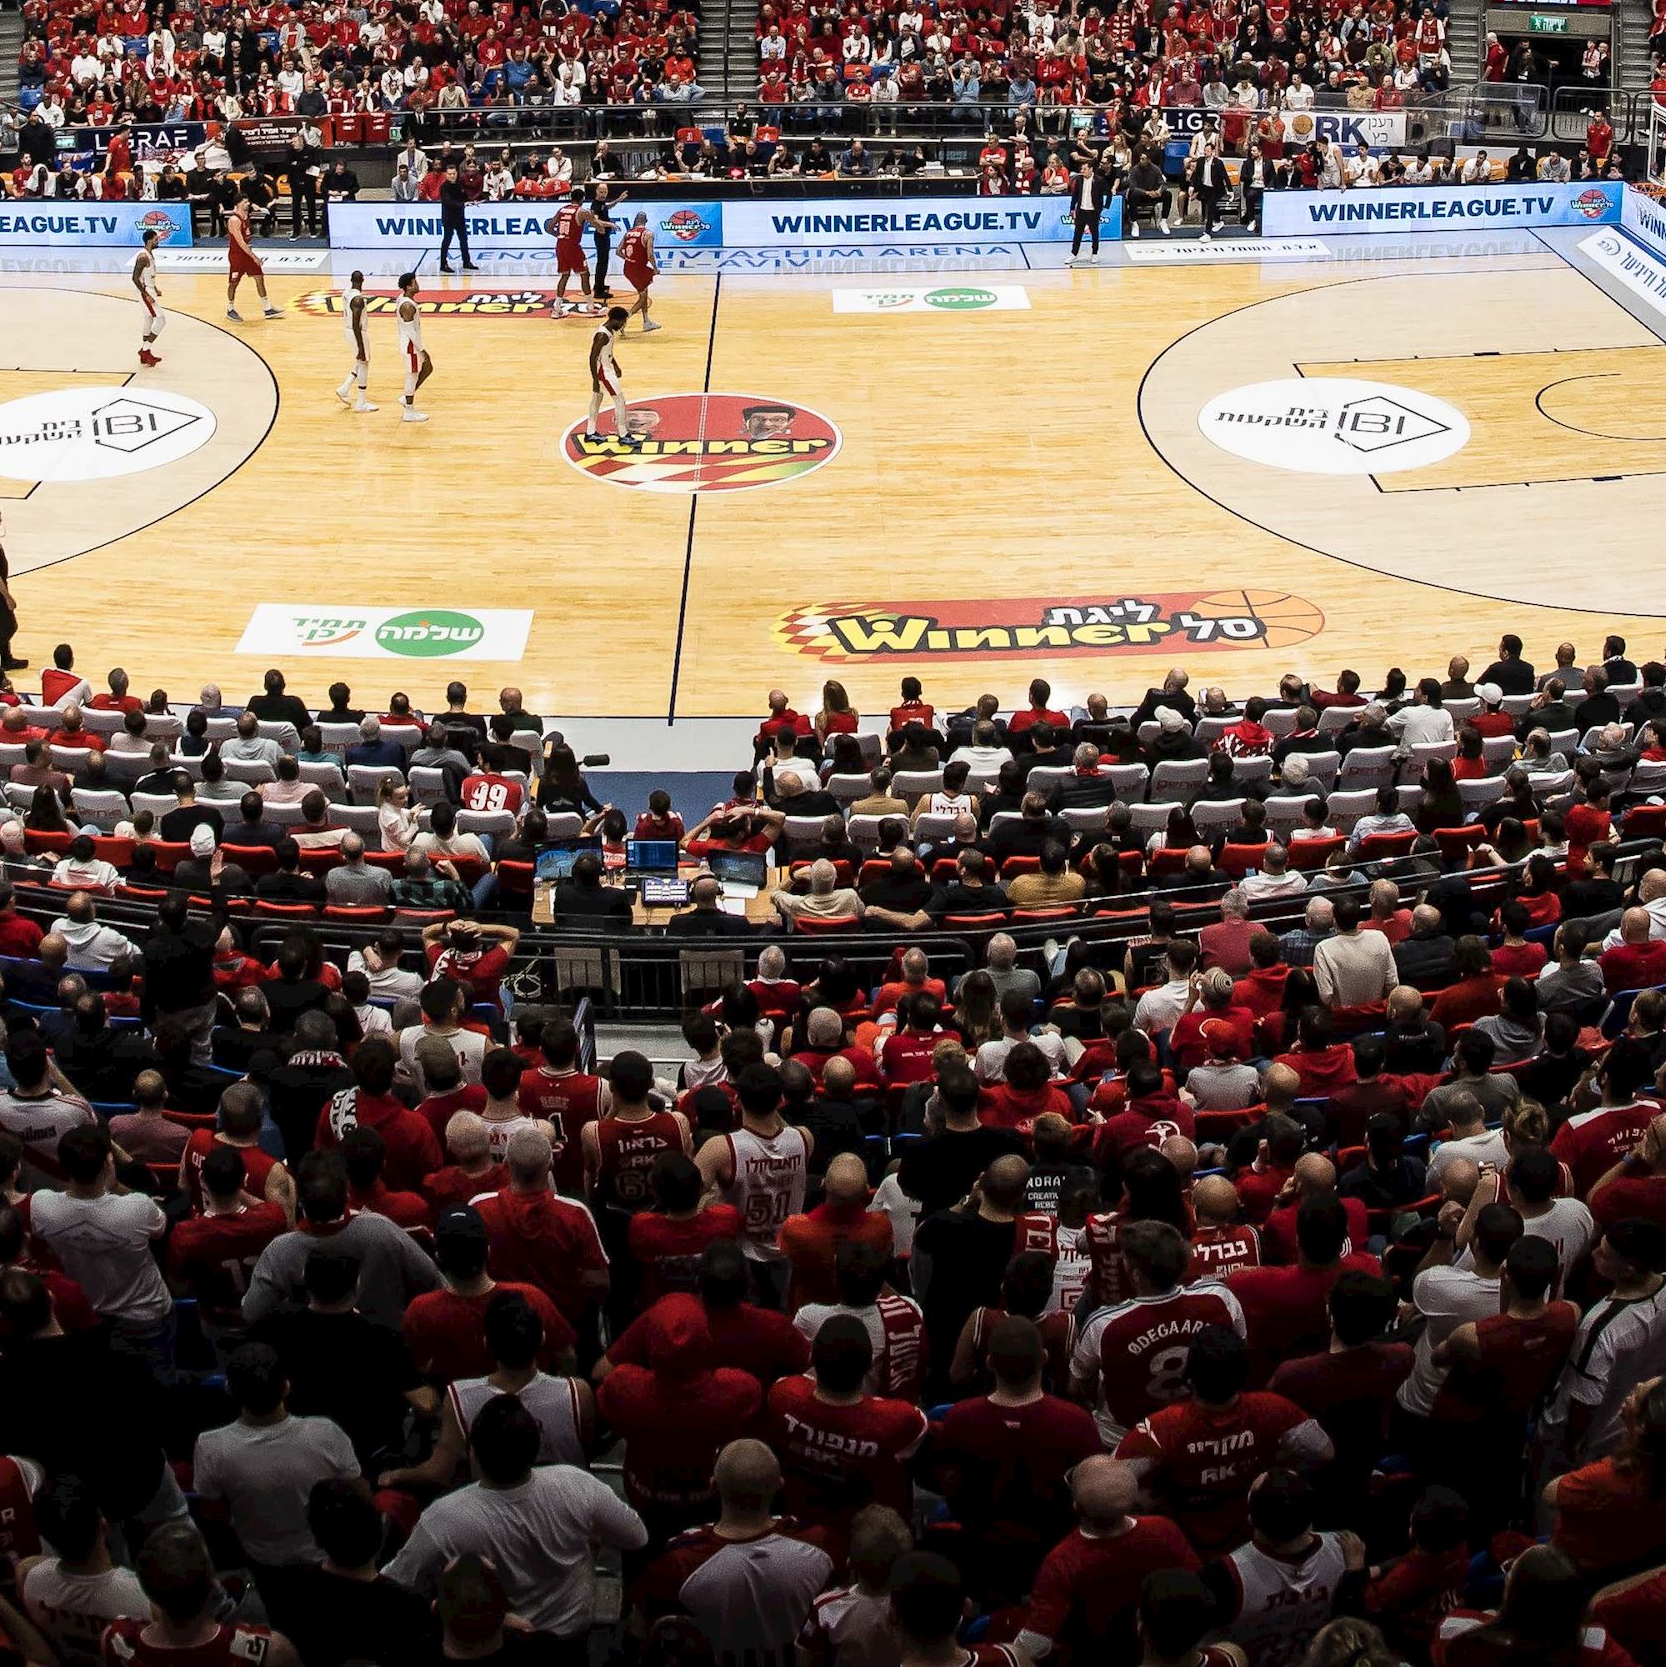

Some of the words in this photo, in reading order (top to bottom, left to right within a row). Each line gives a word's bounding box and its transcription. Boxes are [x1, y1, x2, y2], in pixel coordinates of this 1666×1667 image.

[1368, 117, 1394, 128] רענן
[1372, 133, 1388, 145] כץ
[1309, 195, 1555, 223] WINNERLEAGUE.TV
[771, 211, 1042, 234] WINNERLEAGUE.TV
[879, 244, 1013, 256] ARENA
[1620, 251, 1656, 288] ודיגיטל
[926, 290, 997, 304] שלמה
[576, 433, 833, 457] Winner
[293, 616, 367, 631] תמיד
[1048, 598, 1160, 626] ליגת
[377, 619, 483, 643] שלמה
[833, 615, 1173, 653] Winner
[1182, 614, 1267, 641] סל
[469, 782, 509, 812] 99
[745, 1191, 791, 1225] 51
